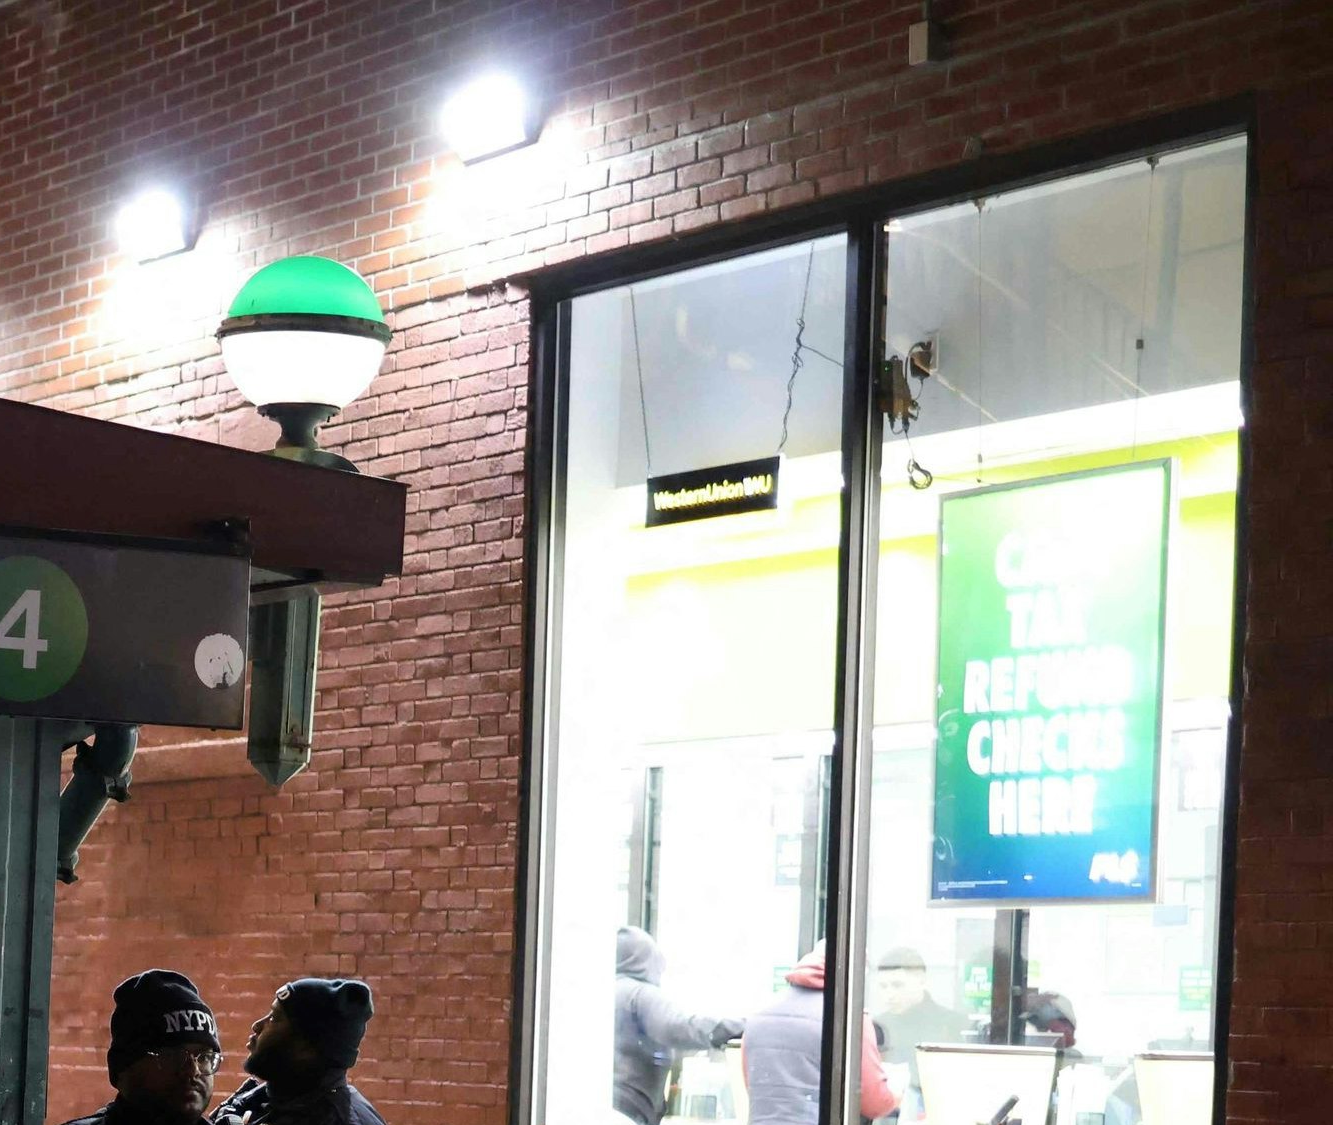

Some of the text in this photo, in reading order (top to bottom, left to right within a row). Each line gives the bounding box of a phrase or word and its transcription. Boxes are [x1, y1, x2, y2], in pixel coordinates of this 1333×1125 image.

[967, 709, 1126, 775] CHECKS
[989, 776, 1097, 835] HERE
[163, 1009, 215, 1038] NYPD
